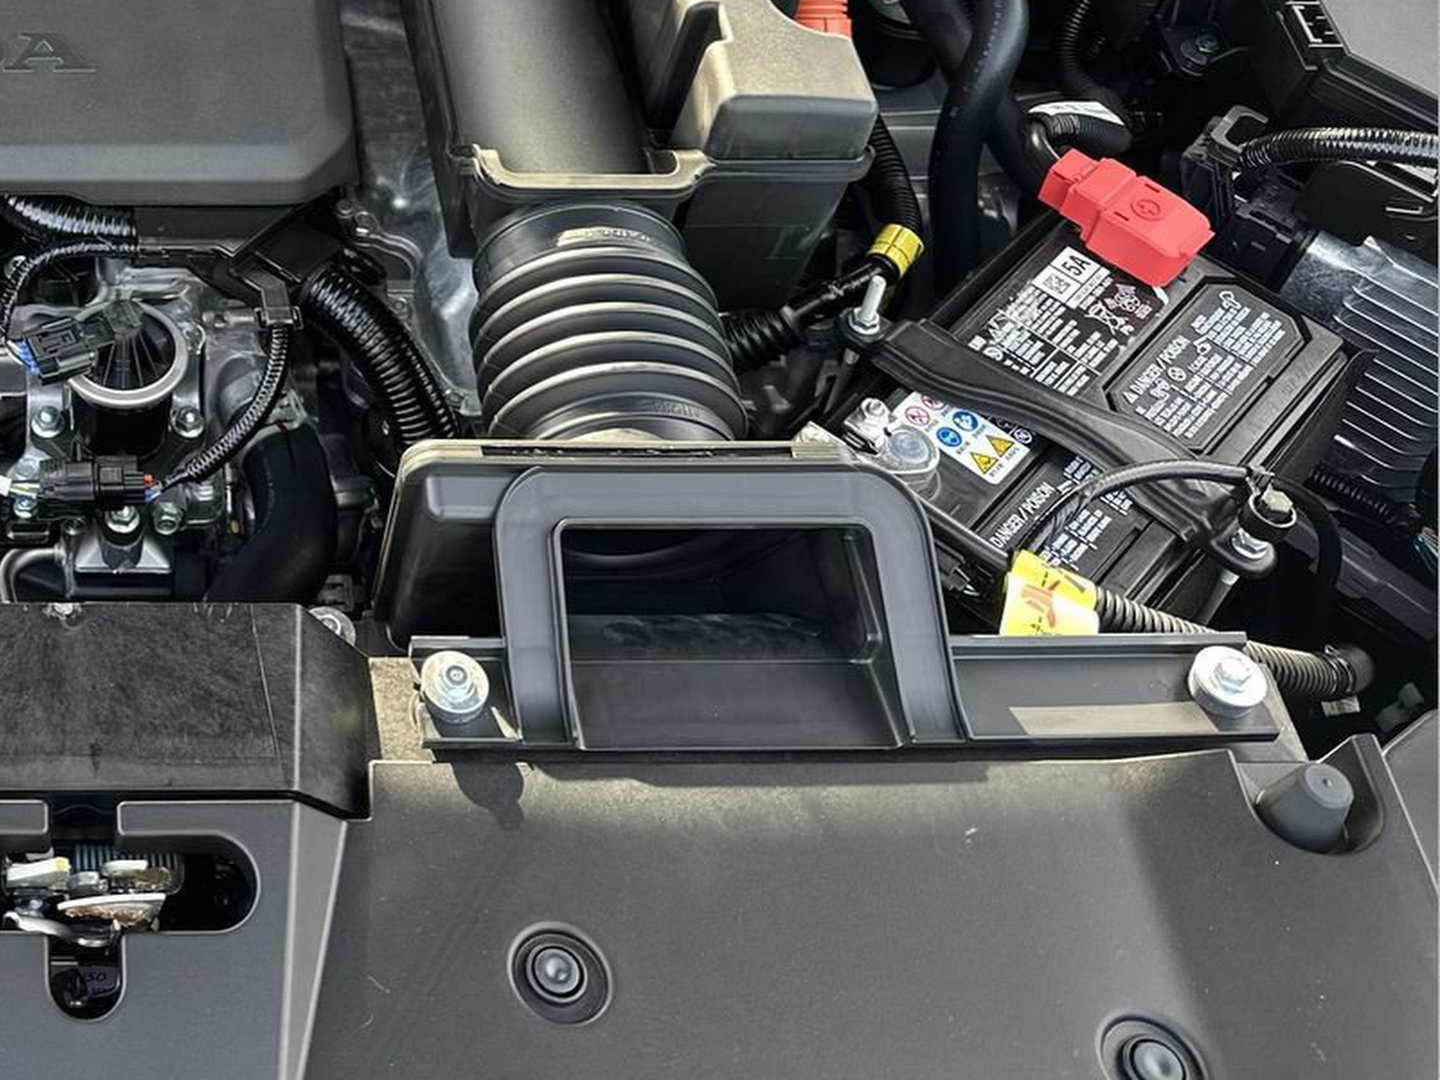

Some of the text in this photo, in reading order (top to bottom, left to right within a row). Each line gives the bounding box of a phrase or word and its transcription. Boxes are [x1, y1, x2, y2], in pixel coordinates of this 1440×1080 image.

[1061, 255, 1092, 278] 5A
[1130, 362, 1164, 397] DANGER
[1160, 334, 1190, 366] POISON
[989, 512, 1025, 549] DANGER
[1026, 481, 1056, 515] POISON
